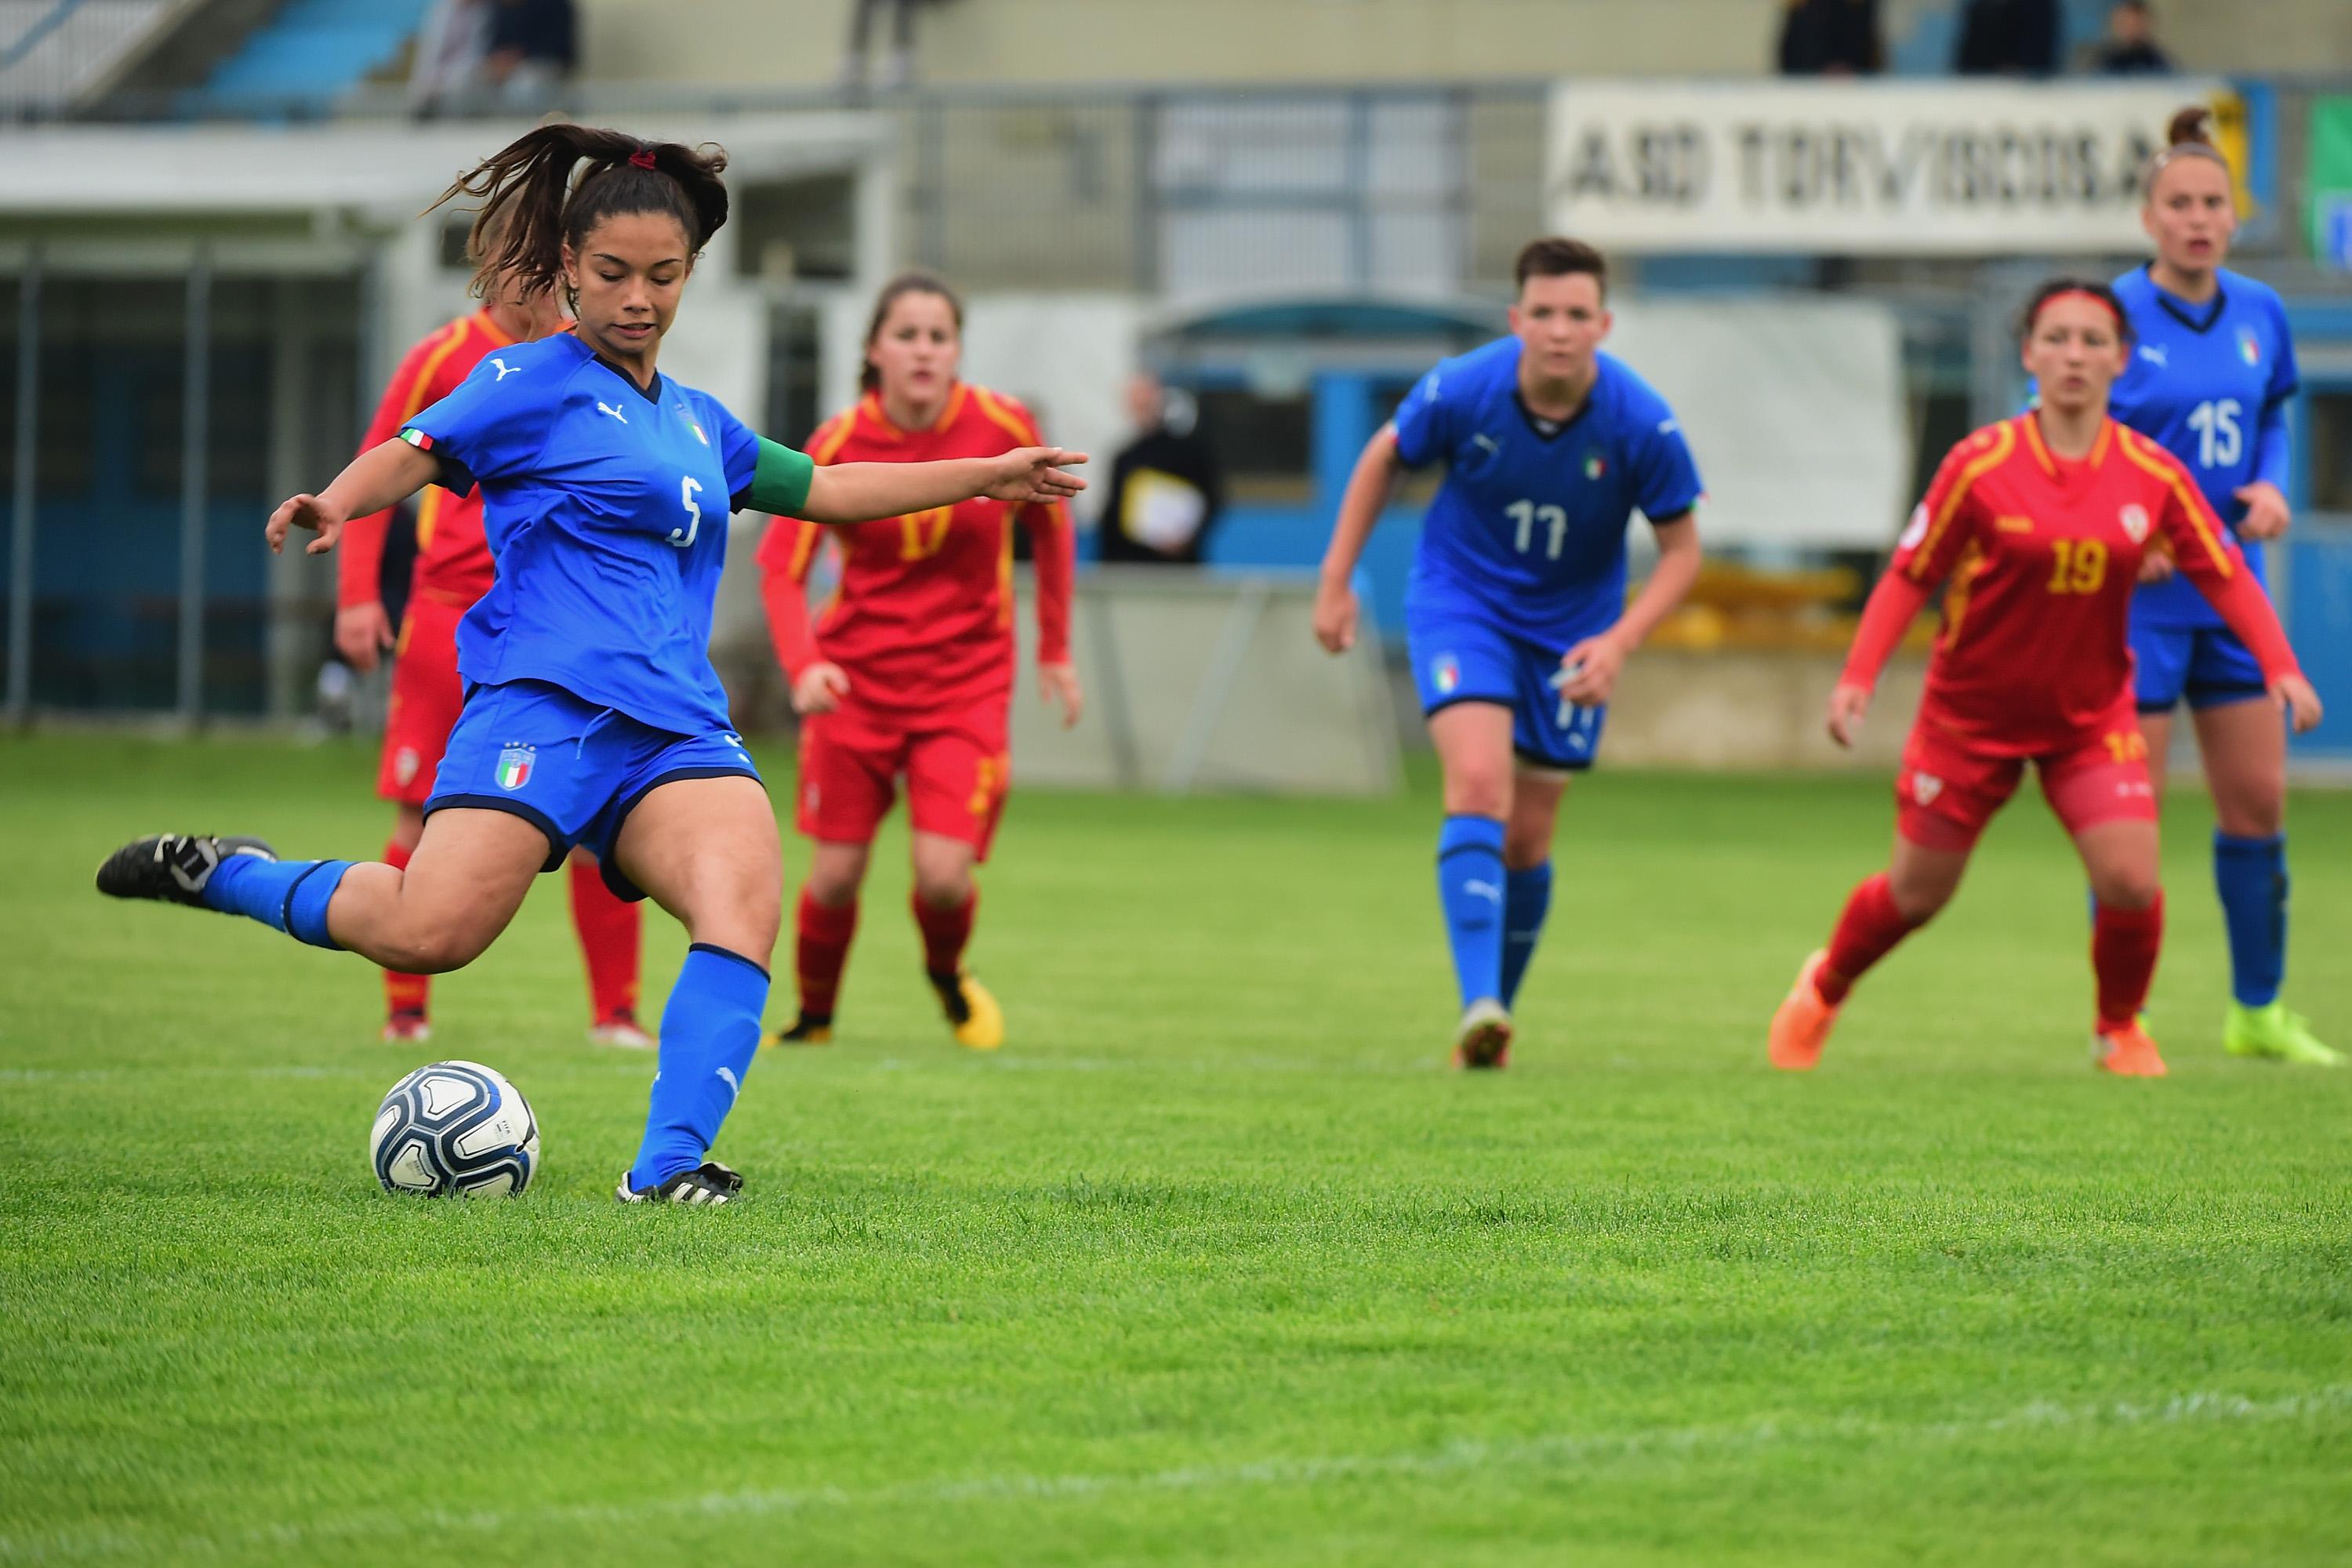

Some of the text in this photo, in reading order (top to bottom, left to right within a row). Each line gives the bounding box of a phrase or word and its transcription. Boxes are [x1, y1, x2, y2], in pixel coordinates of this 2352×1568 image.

[1568, 122, 1711, 206] ASD
[2187, 399, 2241, 469] 15
[665, 475, 702, 547] 5
[900, 507, 953, 560] 17
[2048, 538, 2107, 593] 19
